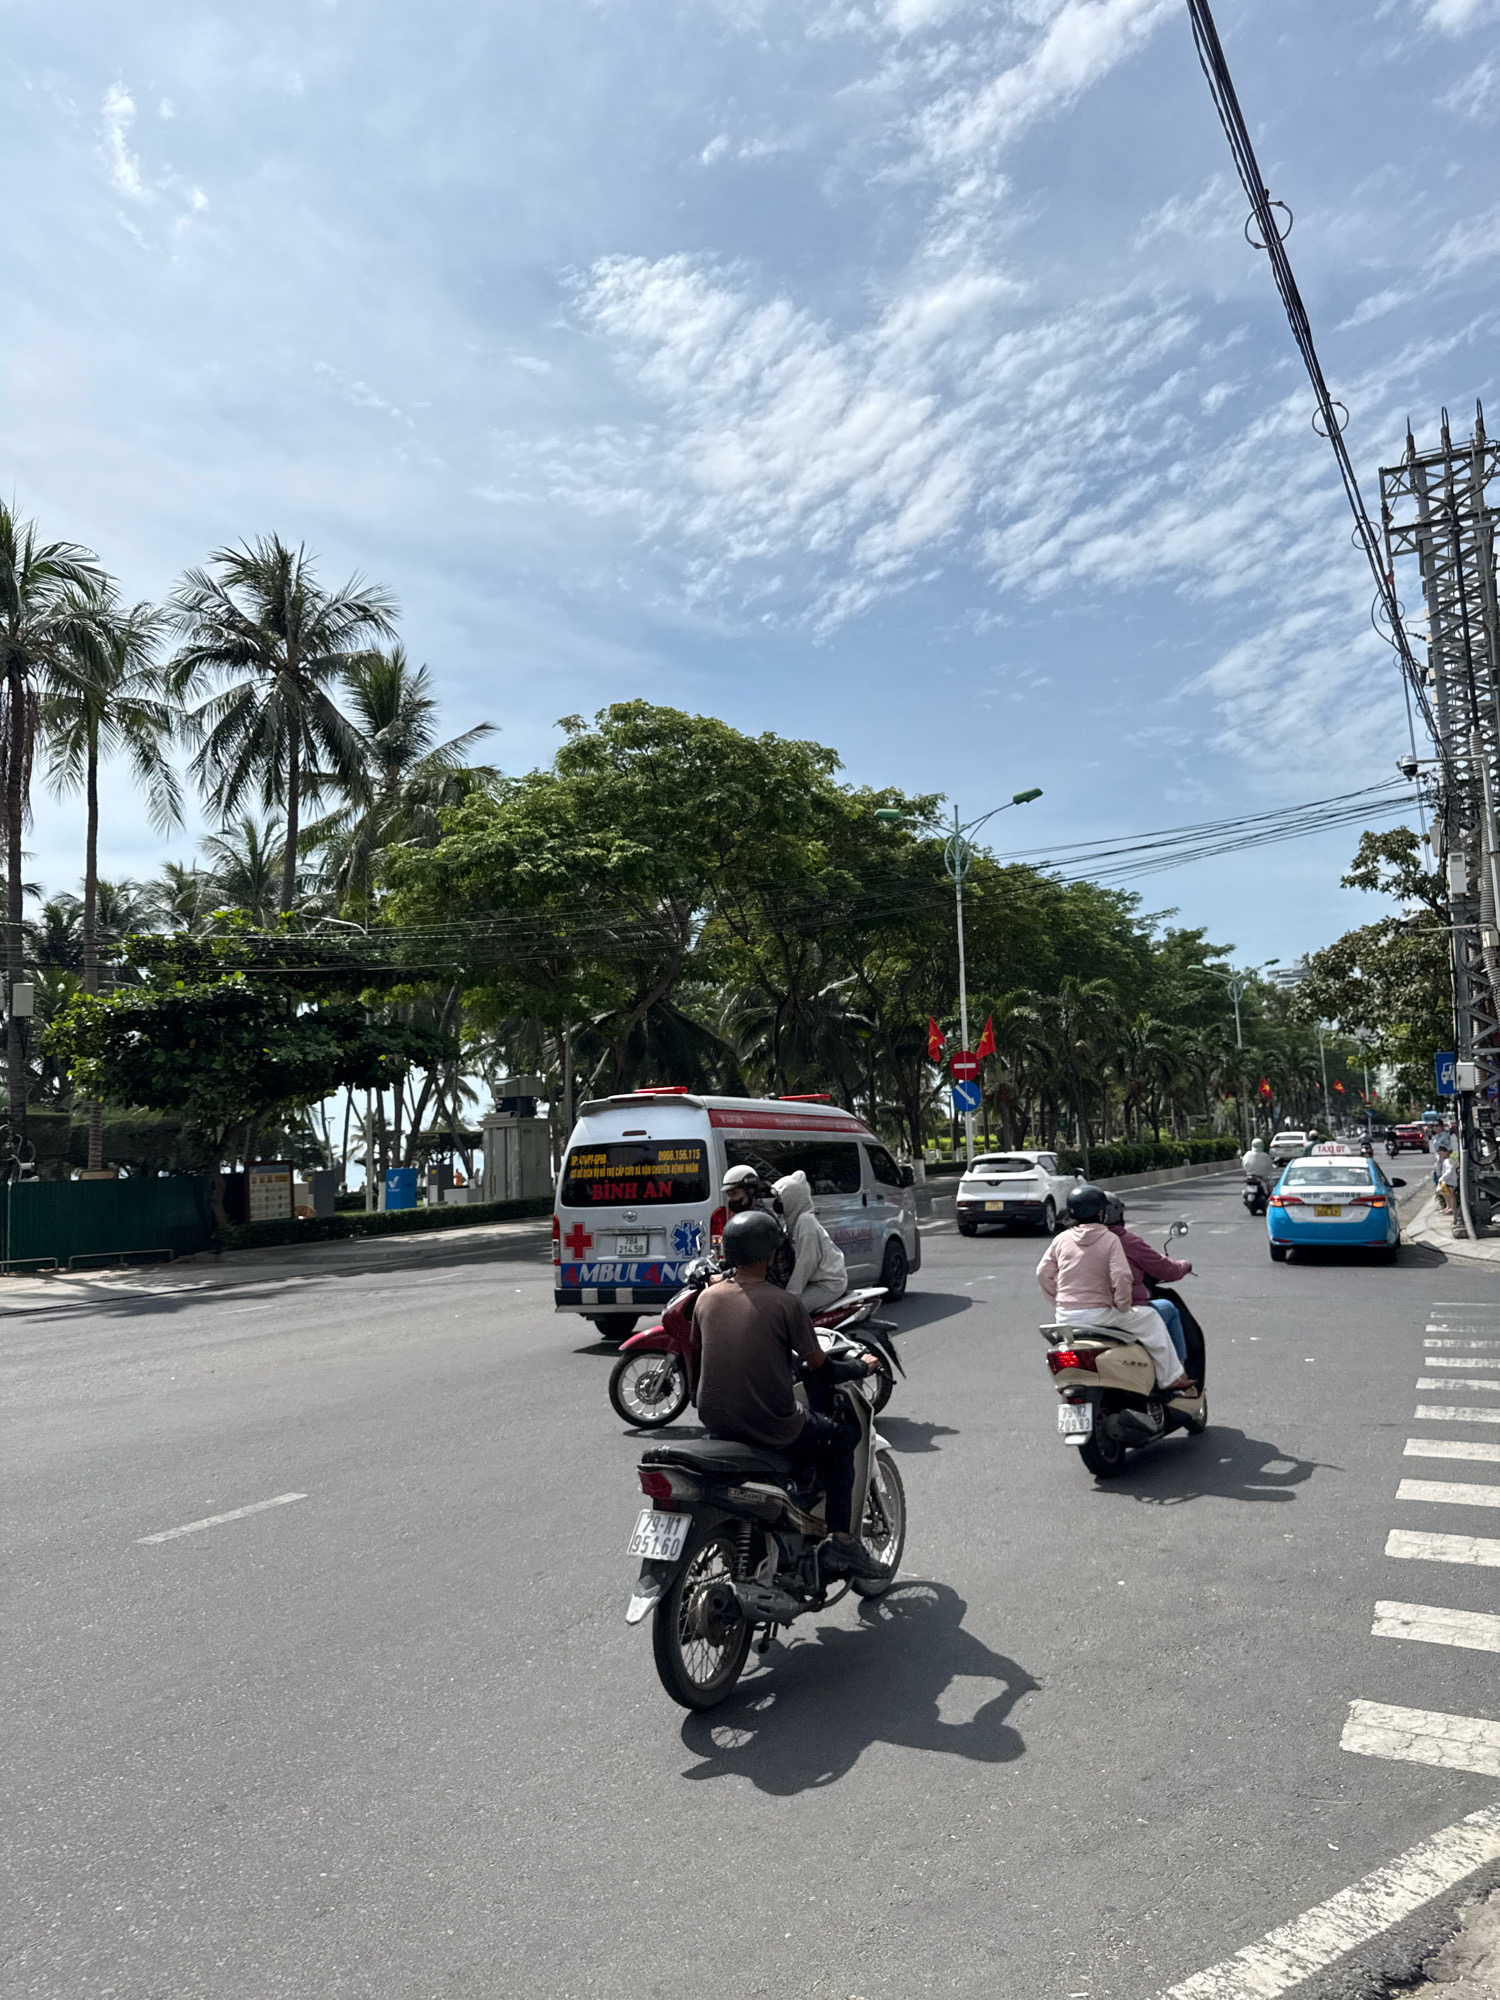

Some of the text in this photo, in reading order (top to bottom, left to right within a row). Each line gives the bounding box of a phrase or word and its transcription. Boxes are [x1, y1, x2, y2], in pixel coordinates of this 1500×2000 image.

[658, 1149, 700, 1161] 0966.156.115
[1317, 1145, 1334, 1153] TAXI
[592, 1180, 673, 1200] BÌNH AN
[625, 1236, 638, 1244] 78A
[618, 1245, 644, 1253] 214.58
[562, 1264, 694, 1286] AMBULANC
[1059, 1419, 1090, 1432] 209.83
[642, 1515, 682, 1536] 79-N1
[632, 1535, 681, 1557] 951.60
